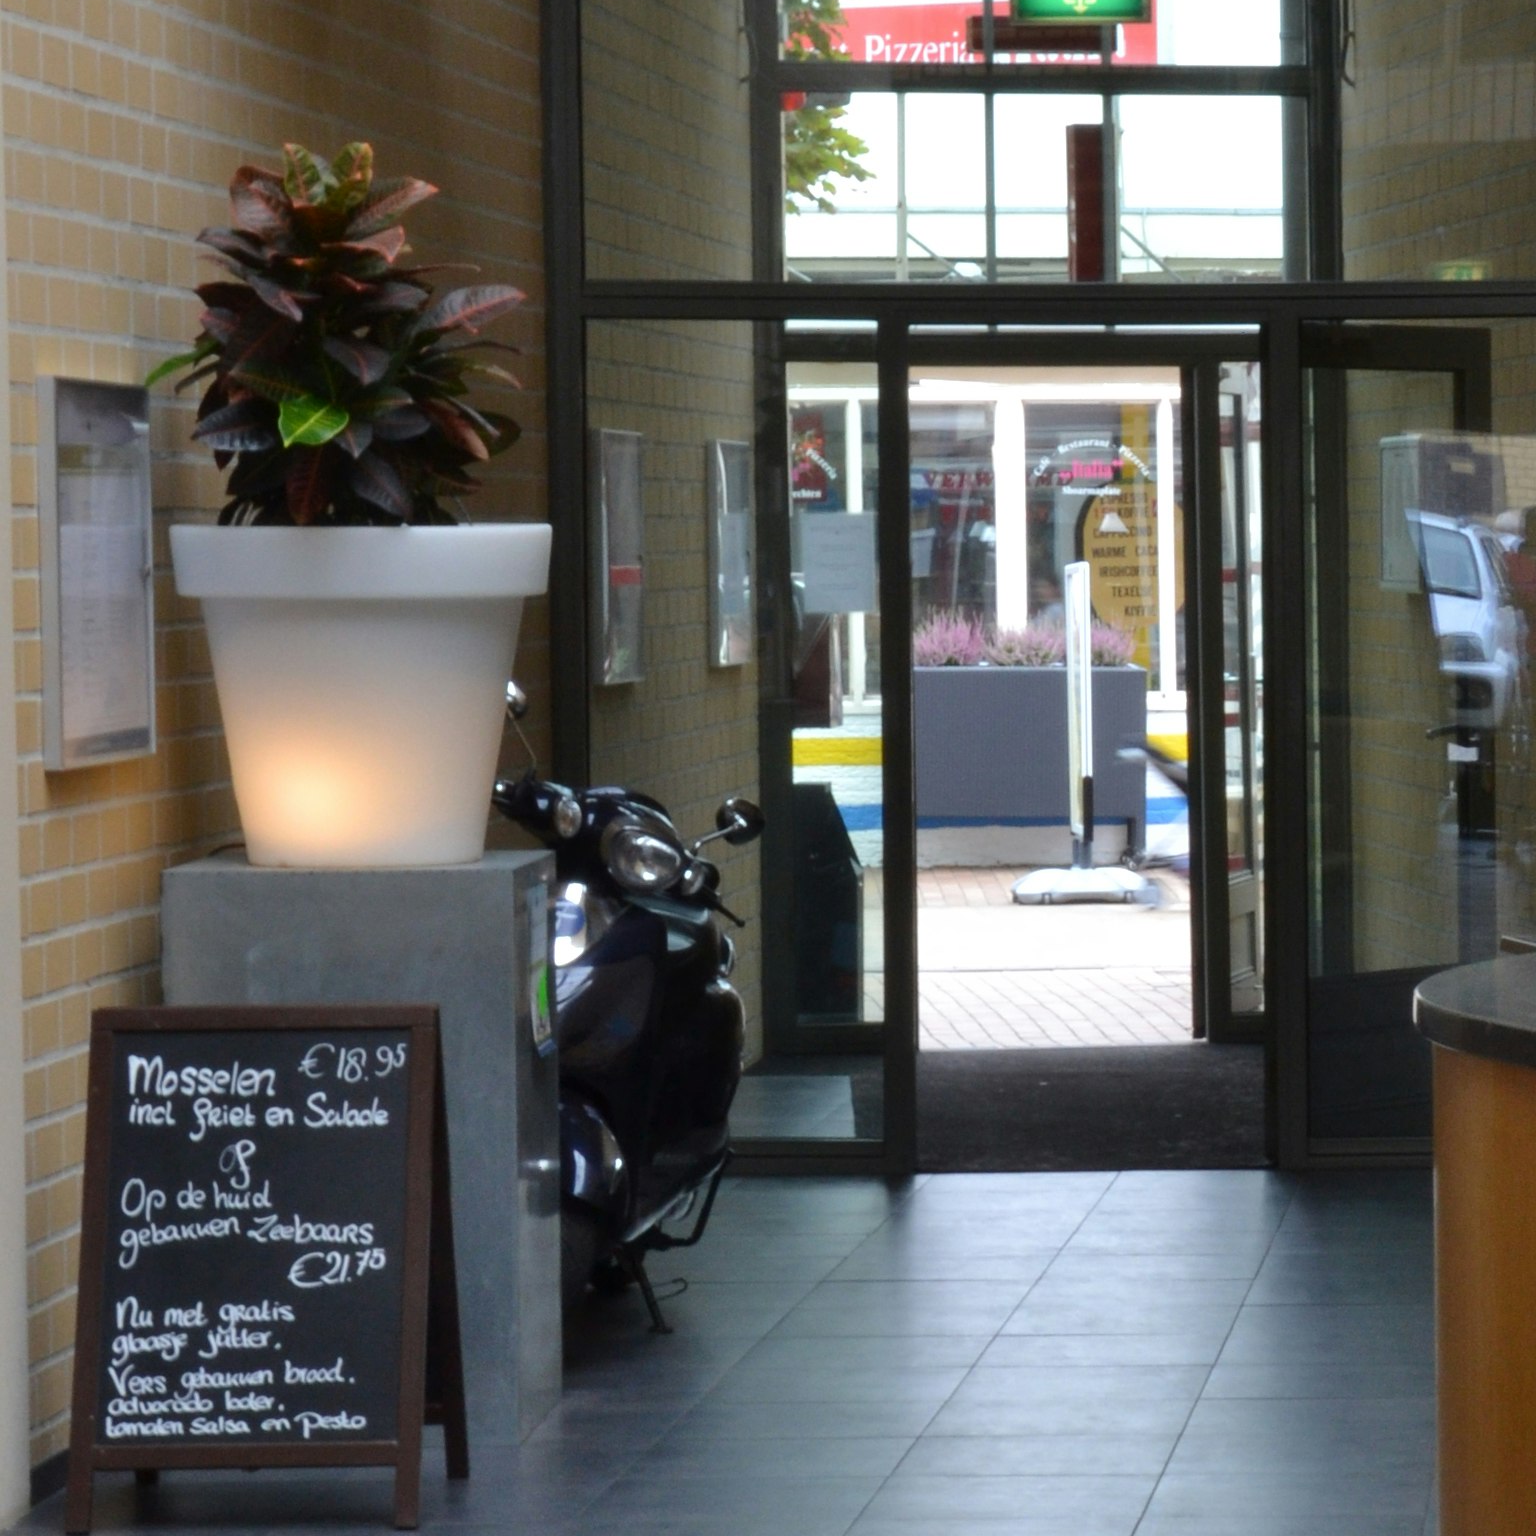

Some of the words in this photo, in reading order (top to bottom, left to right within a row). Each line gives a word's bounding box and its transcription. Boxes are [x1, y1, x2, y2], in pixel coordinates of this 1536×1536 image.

[864, 31, 976, 64] Pizzeria
[127, 1054, 276, 1097] Mosselen
[129, 1098, 176, 1125] incl
[189, 1097, 256, 1143] friet
[264, 1105, 295, 1127] en
[121, 1177, 167, 1222] Op
[176, 1180, 207, 1211] de
[213, 1179, 272, 1210] huid
[116, 1296, 154, 1330] Nu
[163, 1301, 209, 1328] met
[218, 1300, 296, 1332] gratis
[111, 1331, 188, 1367] glaasje
[105, 1415, 185, 1439] tomaten
[261, 1415, 292, 1432] en
